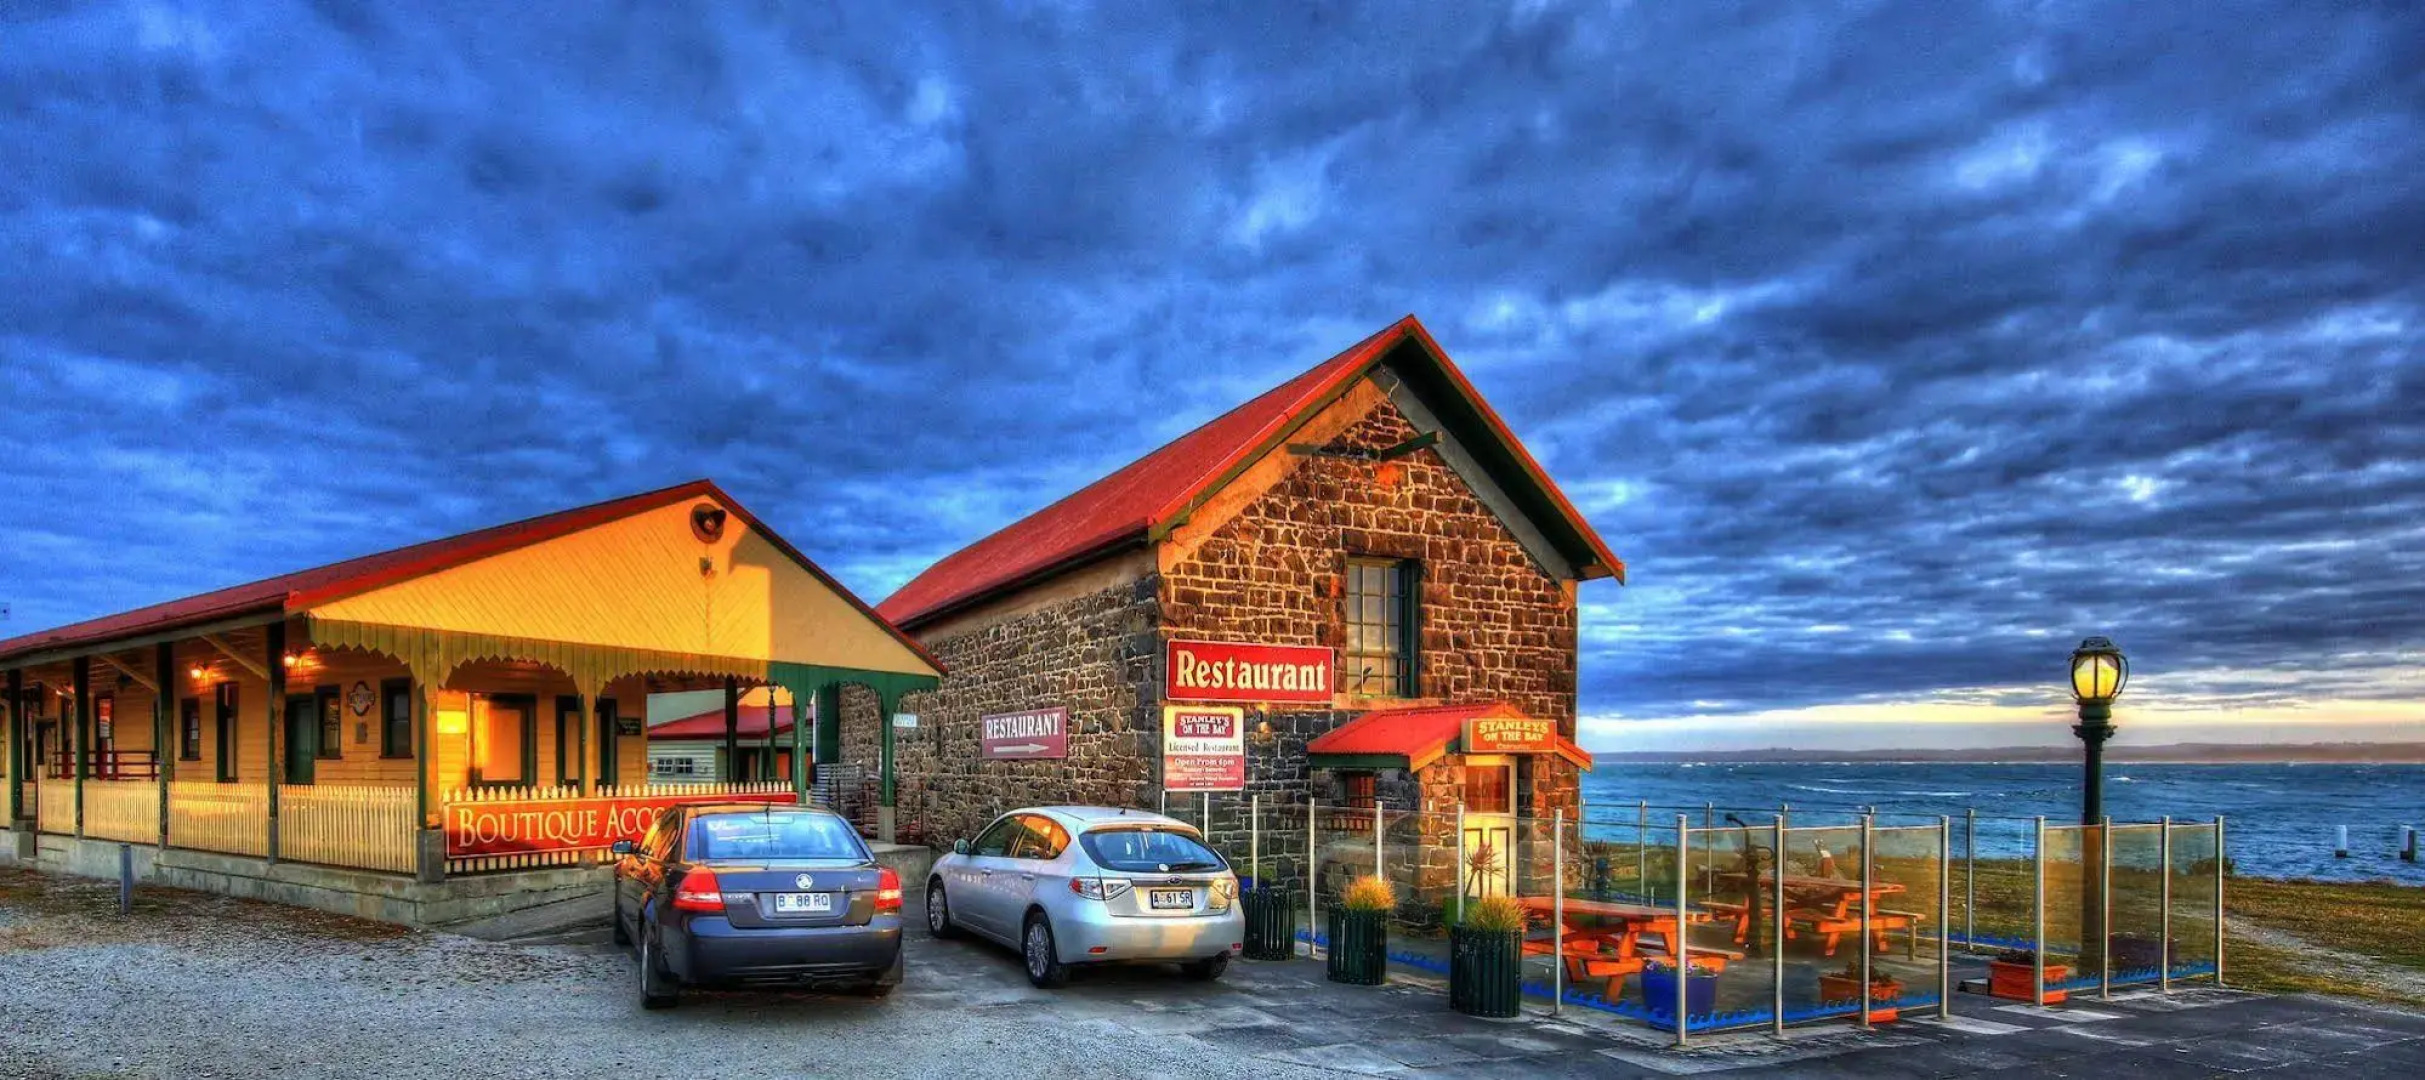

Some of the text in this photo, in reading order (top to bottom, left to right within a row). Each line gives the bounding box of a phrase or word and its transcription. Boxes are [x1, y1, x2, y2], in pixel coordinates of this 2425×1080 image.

[1176, 649, 1327, 692] Restaurant
[985, 712, 1061, 740] RESTAURANT
[1179, 715, 1231, 728] STANLEY'S
[1478, 721, 1549, 734] STANLEYS
[1183, 723, 1227, 735] ON THE BAY
[1484, 731, 1544, 741] ON THE BAY
[1168, 742, 1240, 753] Licensed Restaurant
[1174, 757, 1195, 767] Open
[1196, 758, 1217, 766] From
[458, 807, 598, 848] BOUTIQUE
